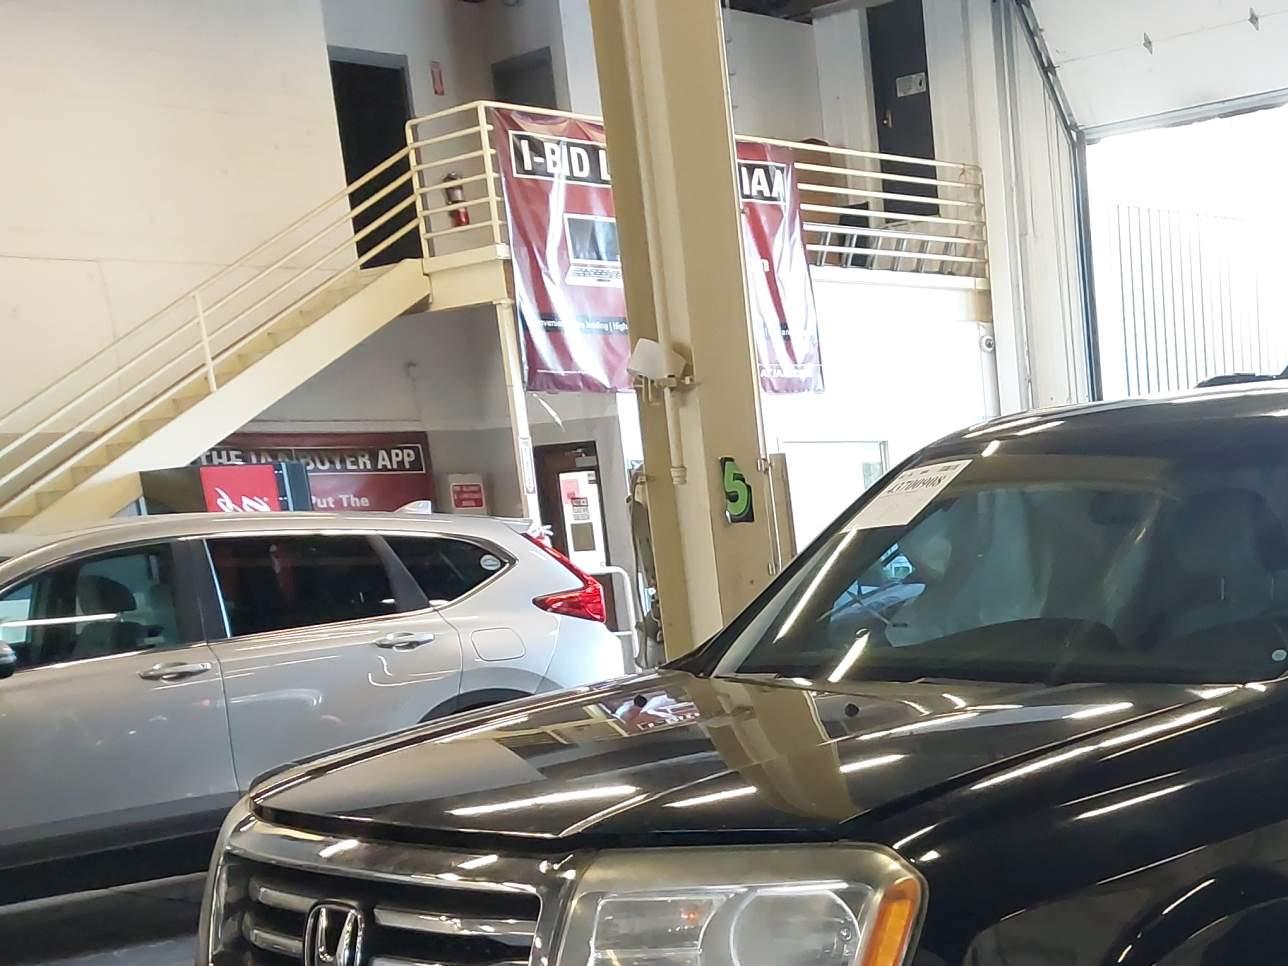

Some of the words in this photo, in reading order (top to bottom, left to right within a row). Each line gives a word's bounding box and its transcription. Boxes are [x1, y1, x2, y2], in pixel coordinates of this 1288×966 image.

[520, 139, 591, 178] I-BID
[377, 449, 415, 469] APP
[340, 495, 369, 507] The
[725, 461, 748, 515] 5
